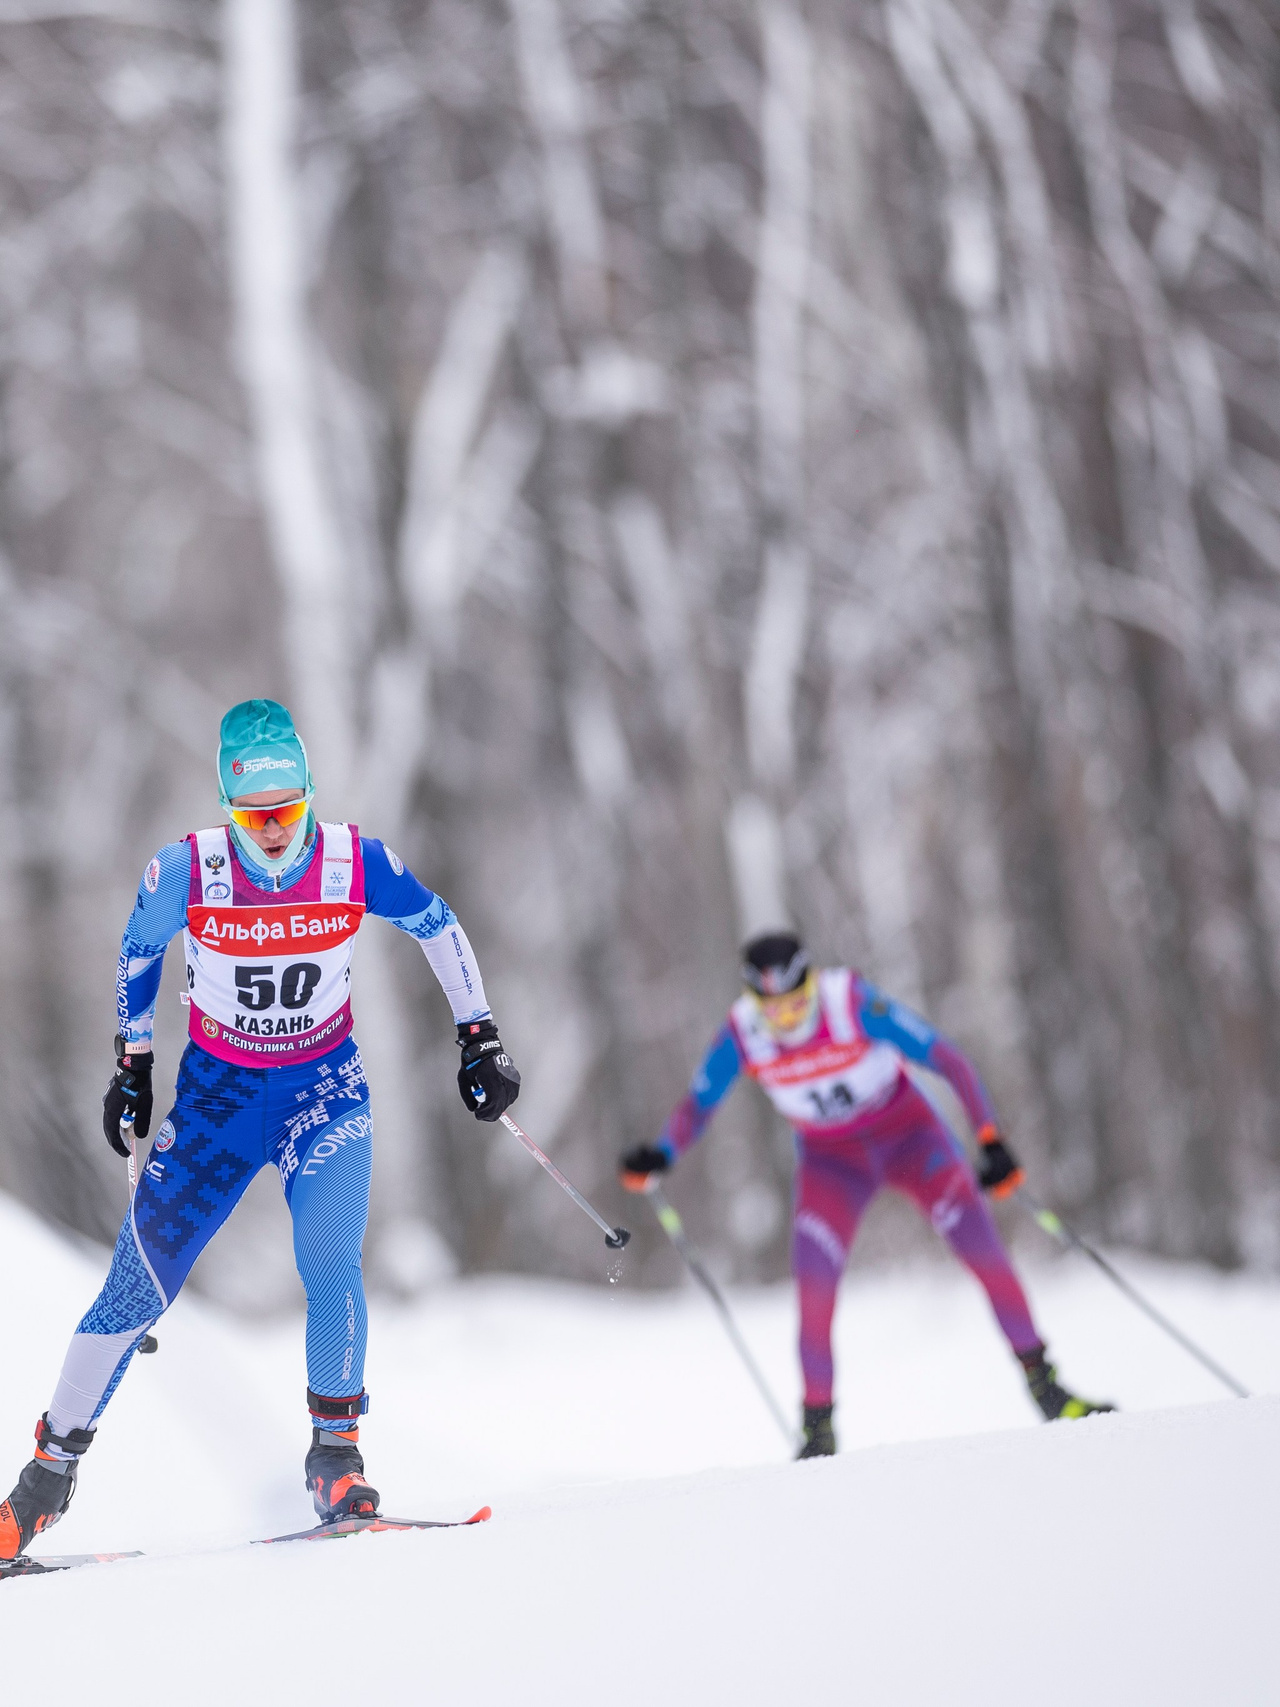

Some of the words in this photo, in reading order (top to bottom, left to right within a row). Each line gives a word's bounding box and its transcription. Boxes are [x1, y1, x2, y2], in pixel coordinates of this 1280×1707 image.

[201, 915, 285, 946] Альфа
[290, 914, 350, 938] Банк
[451, 931, 463, 957] CODE
[235, 962, 322, 1011] 50
[460, 961, 473, 995] VICTORY
[222, 1030, 295, 1052] РЕСПУБЛИКА
[298, 1012, 345, 1049] ТАТАРСТАН
[235, 1013, 315, 1036] КАЗАНЬ
[301, 1109, 373, 1175] ПОМОРЬ
